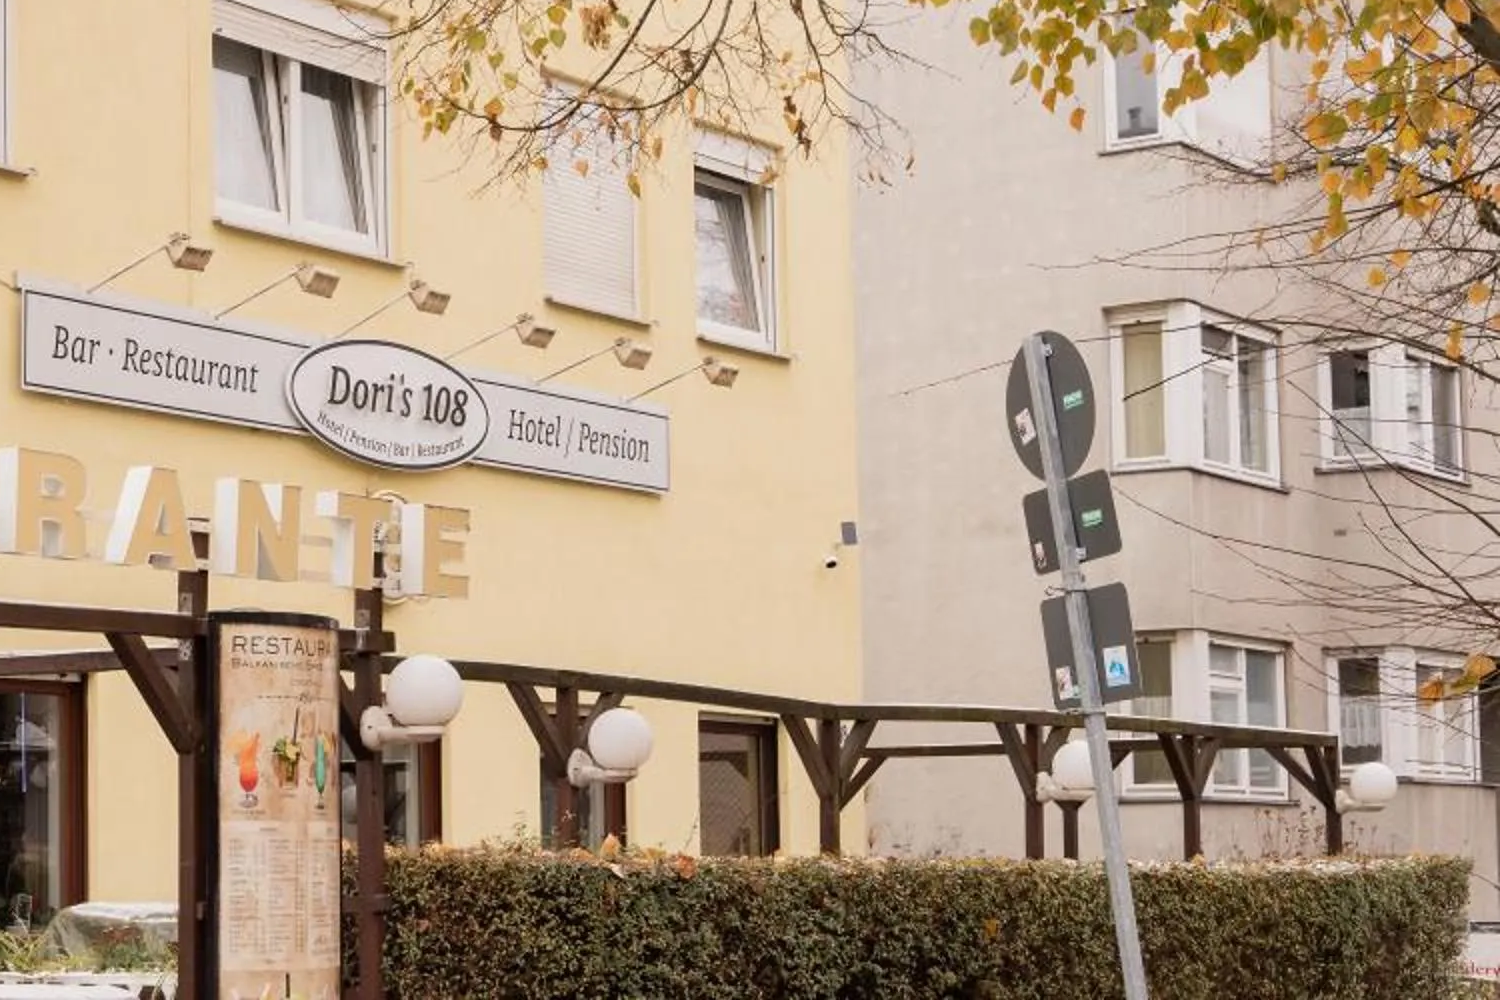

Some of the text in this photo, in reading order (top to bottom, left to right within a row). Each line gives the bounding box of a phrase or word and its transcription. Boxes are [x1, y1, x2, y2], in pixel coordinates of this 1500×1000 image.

[52, 324, 101, 365] Bar
[121, 337, 260, 393] Restaurant
[422, 383, 469, 428] 108
[507, 408, 562, 449] Hotel
[578, 421, 650, 463] Pension
